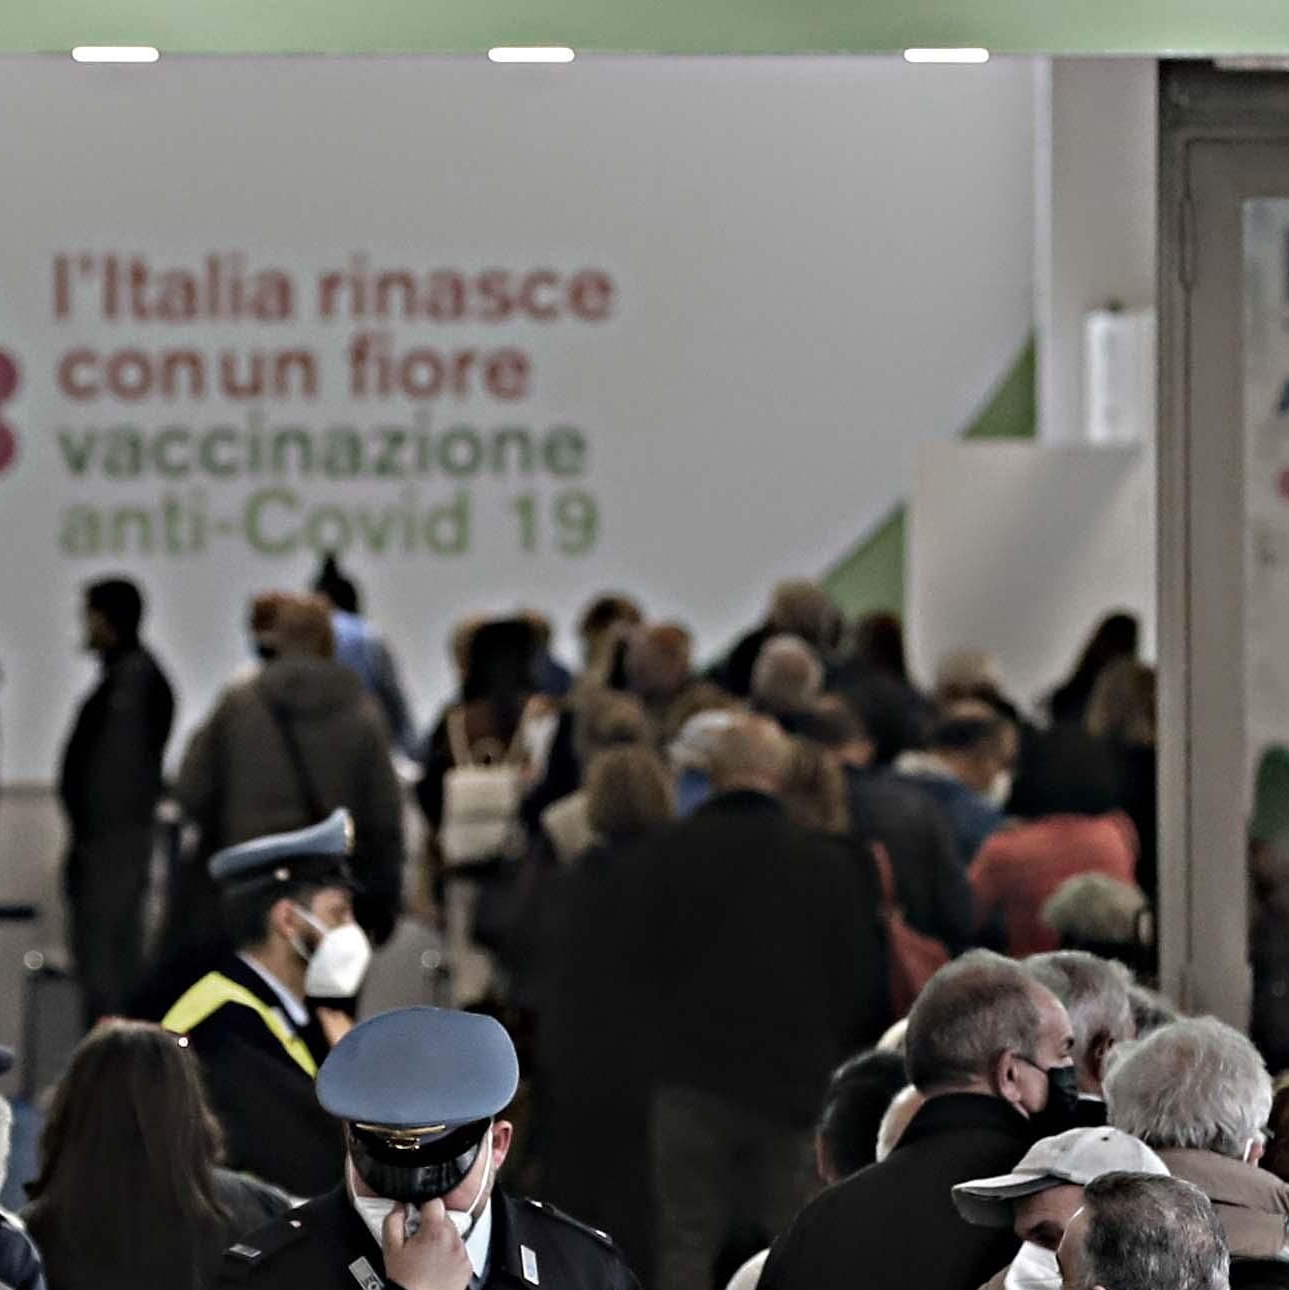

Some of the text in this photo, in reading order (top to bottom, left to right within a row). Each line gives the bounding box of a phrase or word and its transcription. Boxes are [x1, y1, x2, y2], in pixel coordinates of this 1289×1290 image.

[53, 250, 615, 323] l'Italia rinasce
[58, 331, 532, 401] con un fiore
[58, 411, 587, 479] vaccinazione
[62, 487, 600, 557] anti-Covid 19
